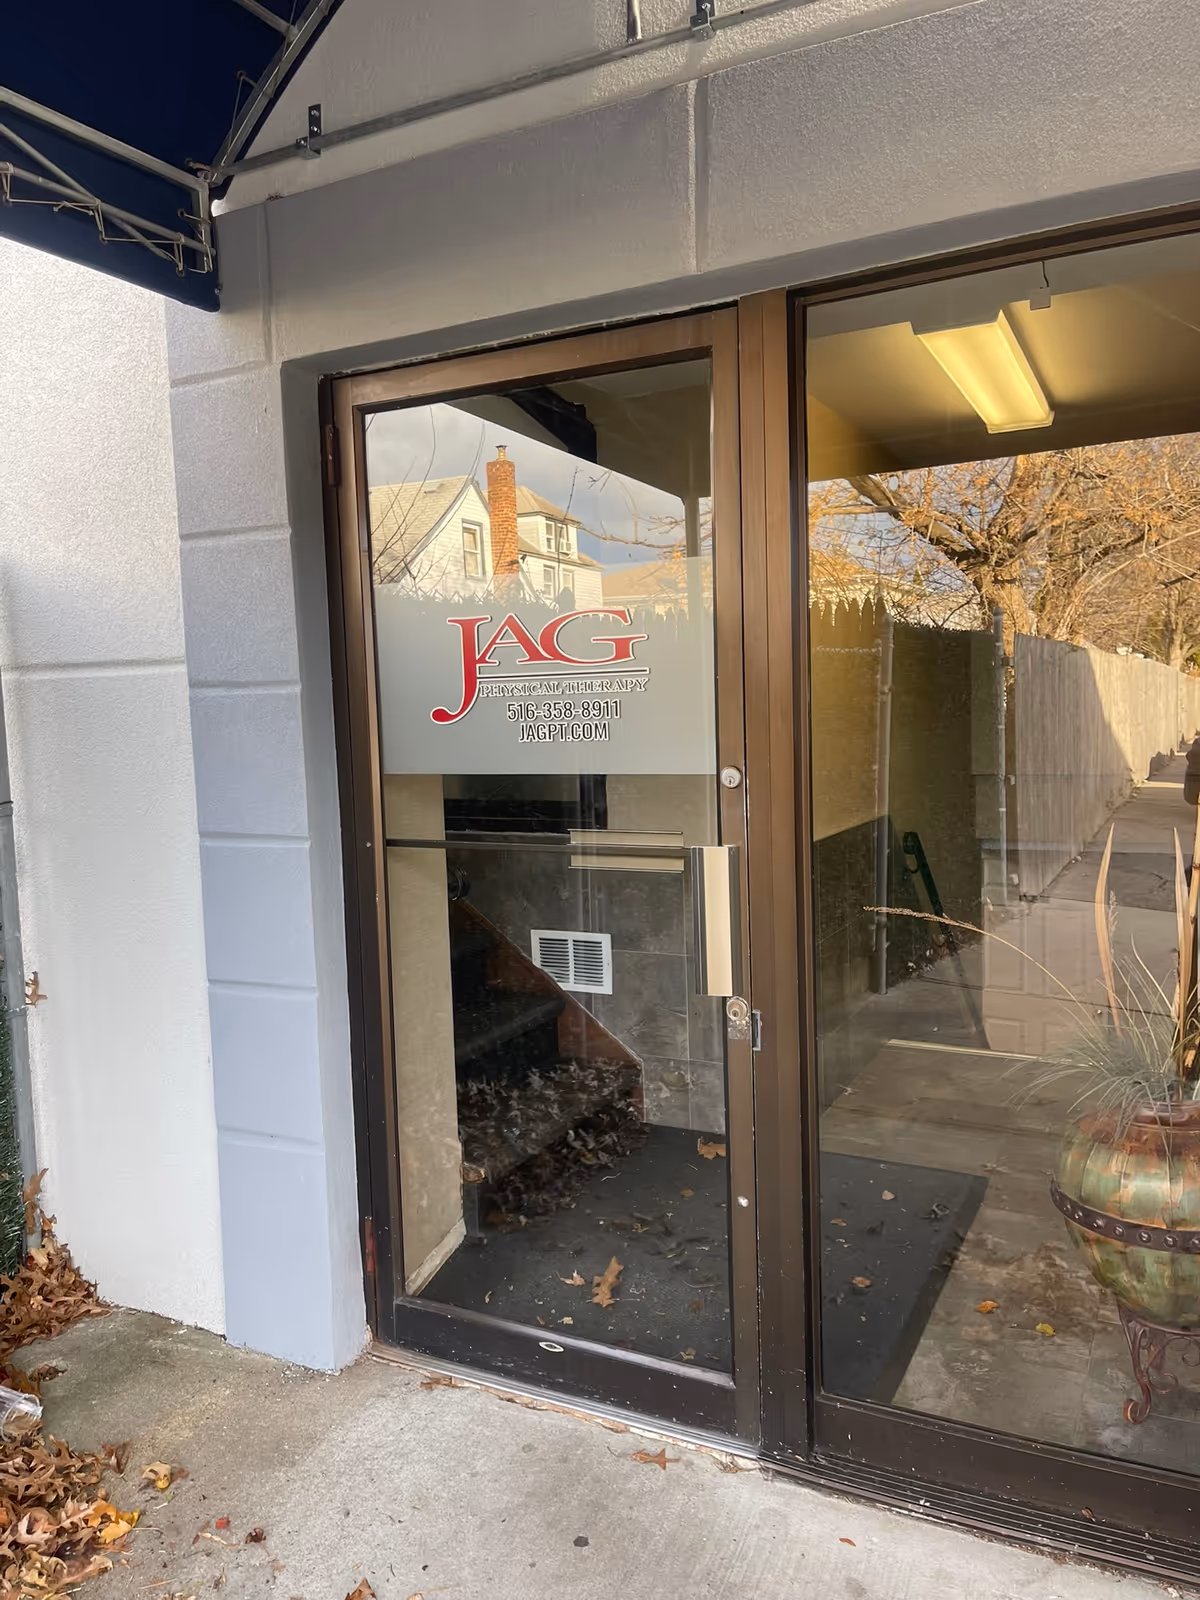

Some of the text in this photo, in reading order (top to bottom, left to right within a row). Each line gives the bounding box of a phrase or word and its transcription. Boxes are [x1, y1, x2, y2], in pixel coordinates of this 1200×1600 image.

[431, 608, 648, 724] JAG
[479, 677, 649, 698] PHYSICAL THERAPY
[507, 699, 621, 721] 516-358-8911
[518, 721, 609, 743] JAGPT.COM
